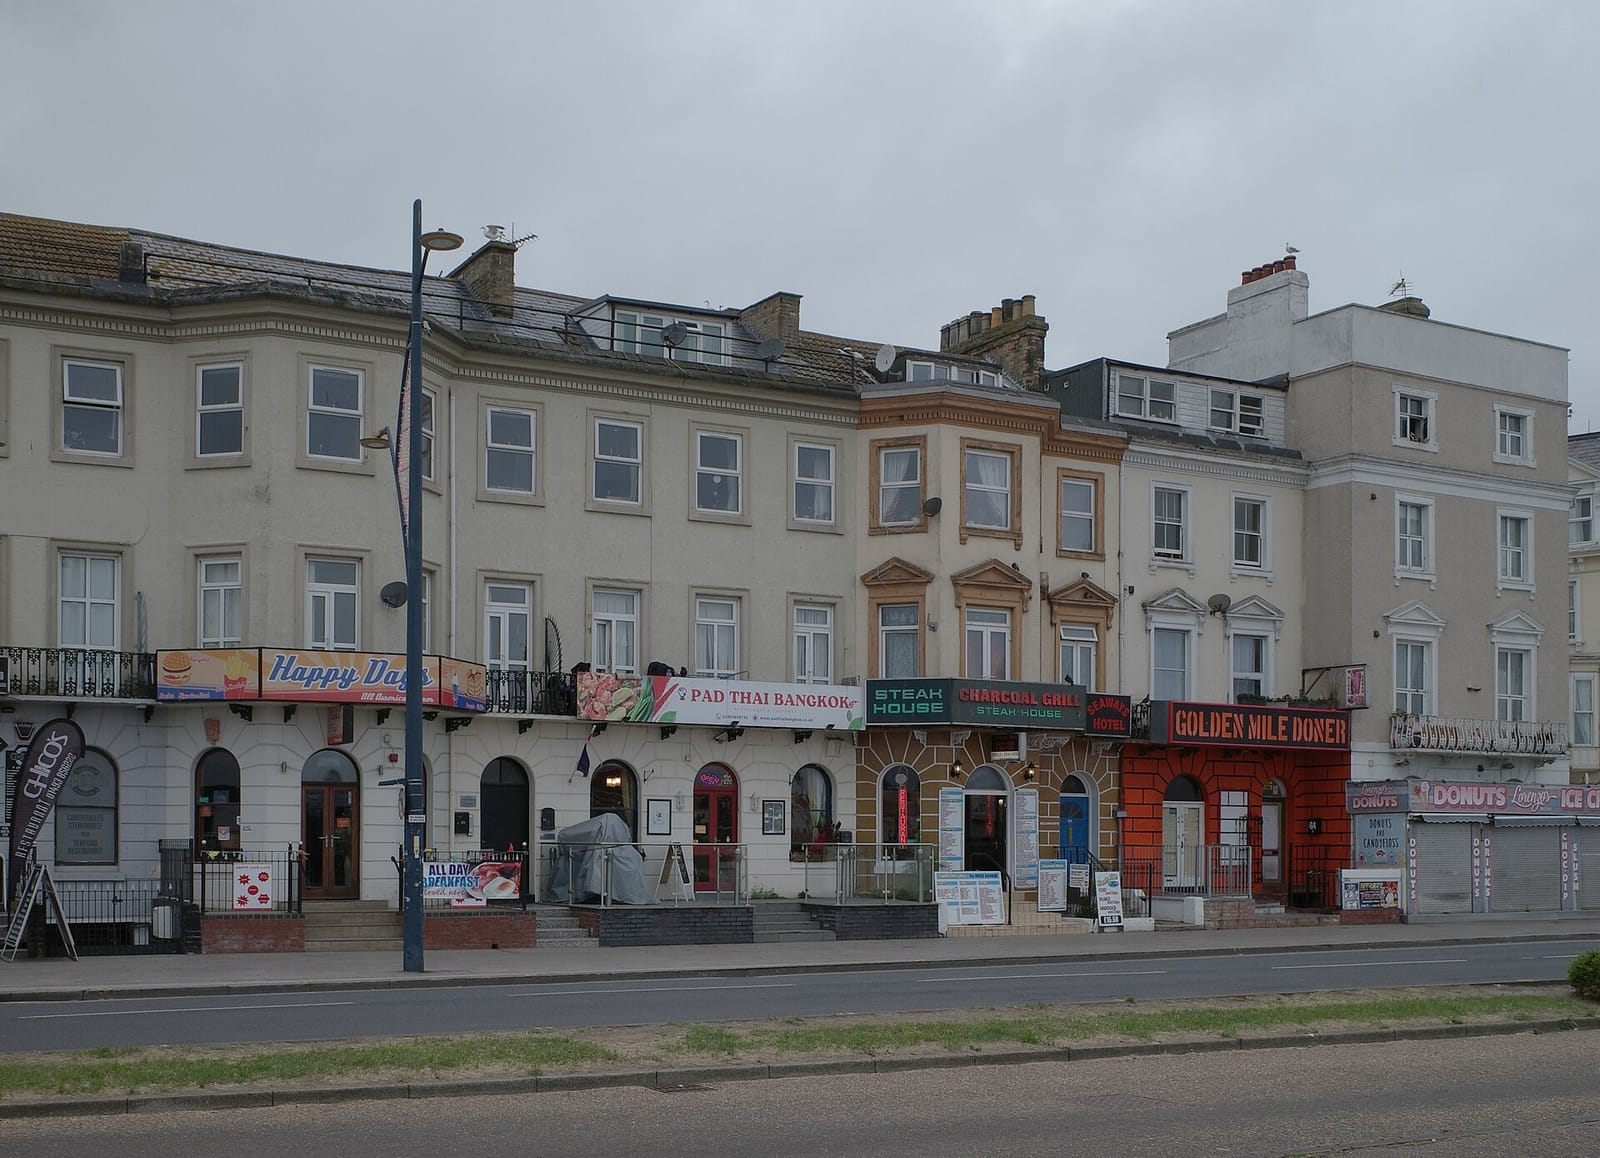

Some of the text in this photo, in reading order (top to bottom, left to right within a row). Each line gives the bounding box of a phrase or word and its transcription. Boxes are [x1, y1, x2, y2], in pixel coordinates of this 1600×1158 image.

[269, 655, 359, 689] Happy
[691, 689, 851, 709] PAD THAI BANGKOK
[874, 688, 943, 700] STEAK
[959, 687, 1080, 708] CHARCOAL GRILL
[872, 702, 944, 714] HOUSE
[976, 706, 1062, 719] STEAK HOUSE
[1087, 697, 1130, 718] SEAWAYS
[1093, 718, 1126, 731] HOTEL
[1175, 709, 1346, 744] GOLDEN MILE DONER
[23, 730, 69, 799] CHICO'S
[701, 774, 720, 784] OPEN
[1352, 797, 1398, 809] DONUTS
[1434, 785, 1507, 808] DONUTS
[1561, 789, 1584, 810] ICE
[15, 799, 52, 859] RESTAURANT
[1369, 819, 1392, 828] DONUTS
[1363, 838, 1399, 848] CANDYFLOSS
[429, 864, 469, 875] ALL DAY
[1409, 838, 1417, 899] DONUTS
